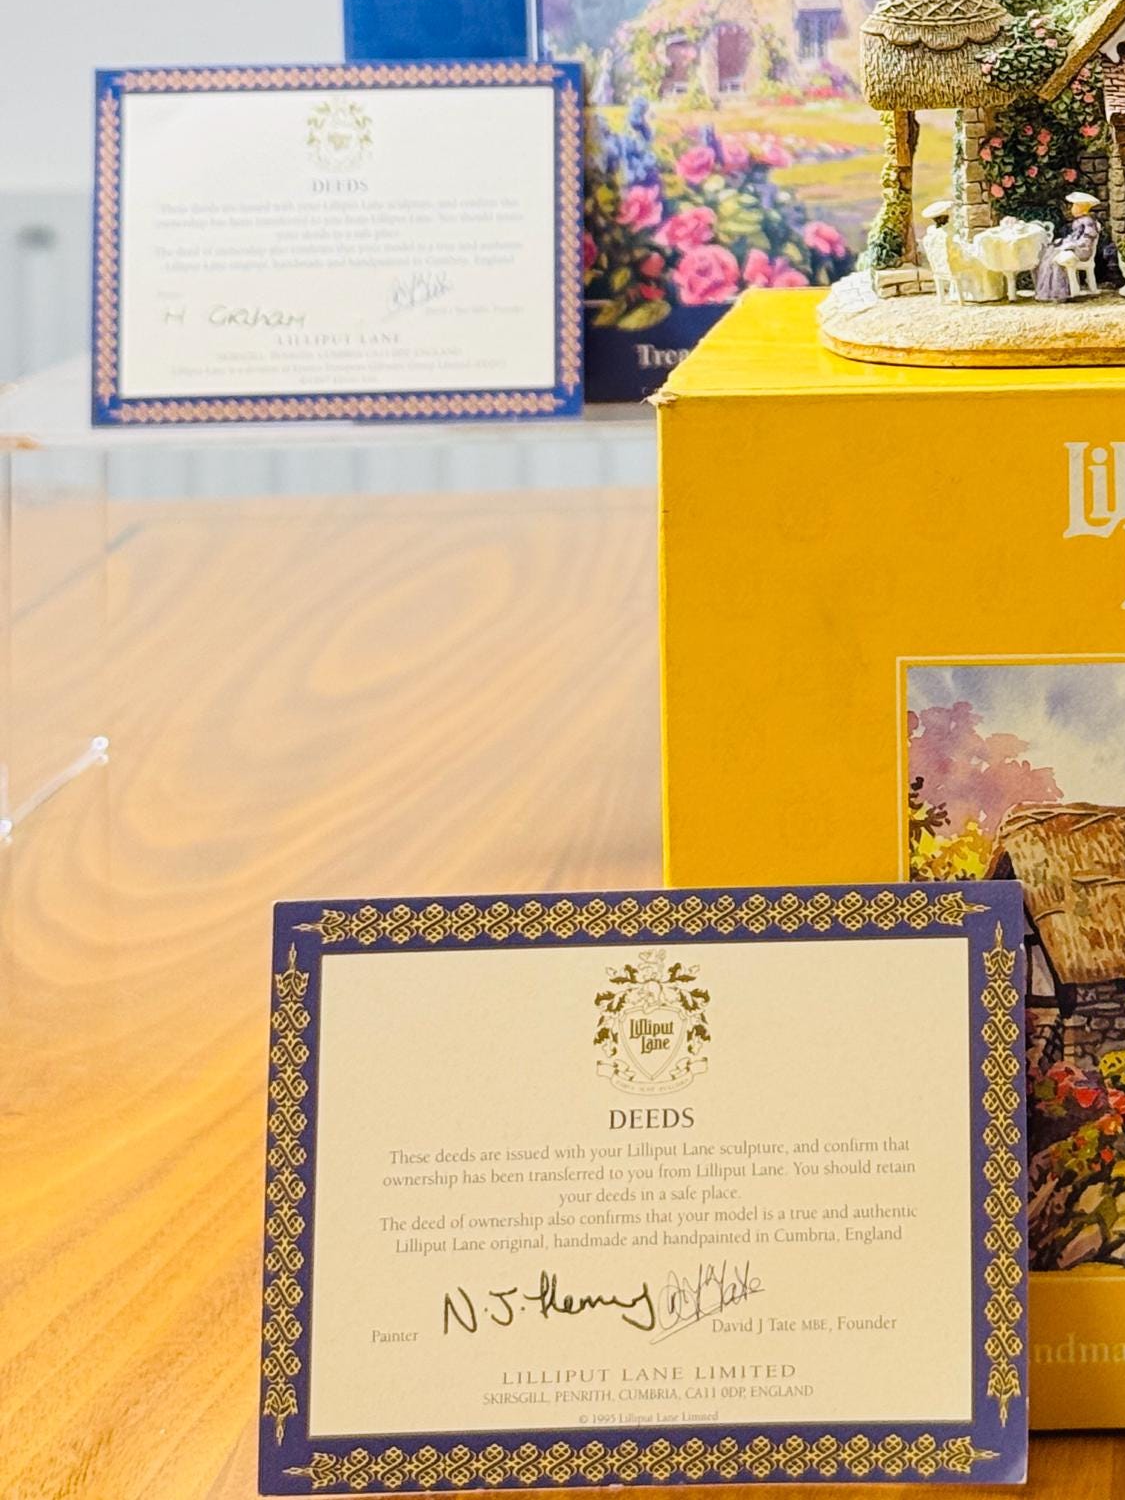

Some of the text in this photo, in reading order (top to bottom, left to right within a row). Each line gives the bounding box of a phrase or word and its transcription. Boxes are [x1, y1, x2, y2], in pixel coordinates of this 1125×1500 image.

[634, 344, 690, 368] Trea
[629, 1018, 675, 1039] Lilliput
[640, 1036, 671, 1055] Lane
[609, 1107, 695, 1130] DEEDS
[390, 1136, 910, 1165] These deeds are issued with your Lilliput Lane sculpture, and confirm that
[383, 1170, 458, 1188] ownership
[462, 1170, 487, 1184] has
[491, 1168, 524, 1183] been
[528, 1165, 605, 1182] transferred
[609, 1167, 624, 1180] to
[628, 1168, 653, 1183] you
[658, 1163, 691, 1178] from
[696, 1162, 746, 1181] Lilliput
[793, 1161, 819, 1176] You
[823, 1159, 871, 1175] should
[875, 1160, 916, 1174] retain
[559, 1184, 742, 1208] your deeds in a safe place.
[379, 1203, 918, 1232] The deed of ownership also confirms that your model is a true and authentic
[395, 1237, 446, 1256] Lilliput
[452, 1237, 487, 1252] Lane
[490, 1235, 549, 1253] original,
[554, 1232, 628, 1249] handmade
[632, 1231, 658, 1246] and
[663, 1229, 751, 1248] handpainted
[756, 1231, 769, 1244] in
[845, 1225, 902, 1244] England
[371, 1329, 418, 1344] Painter
[711, 1315, 897, 1335] David J Tate MBE, Founder
[502, 1364, 796, 1385] LILLIPUT LANE LIMITED
[750, 1384, 814, 1397] ENGLAND
